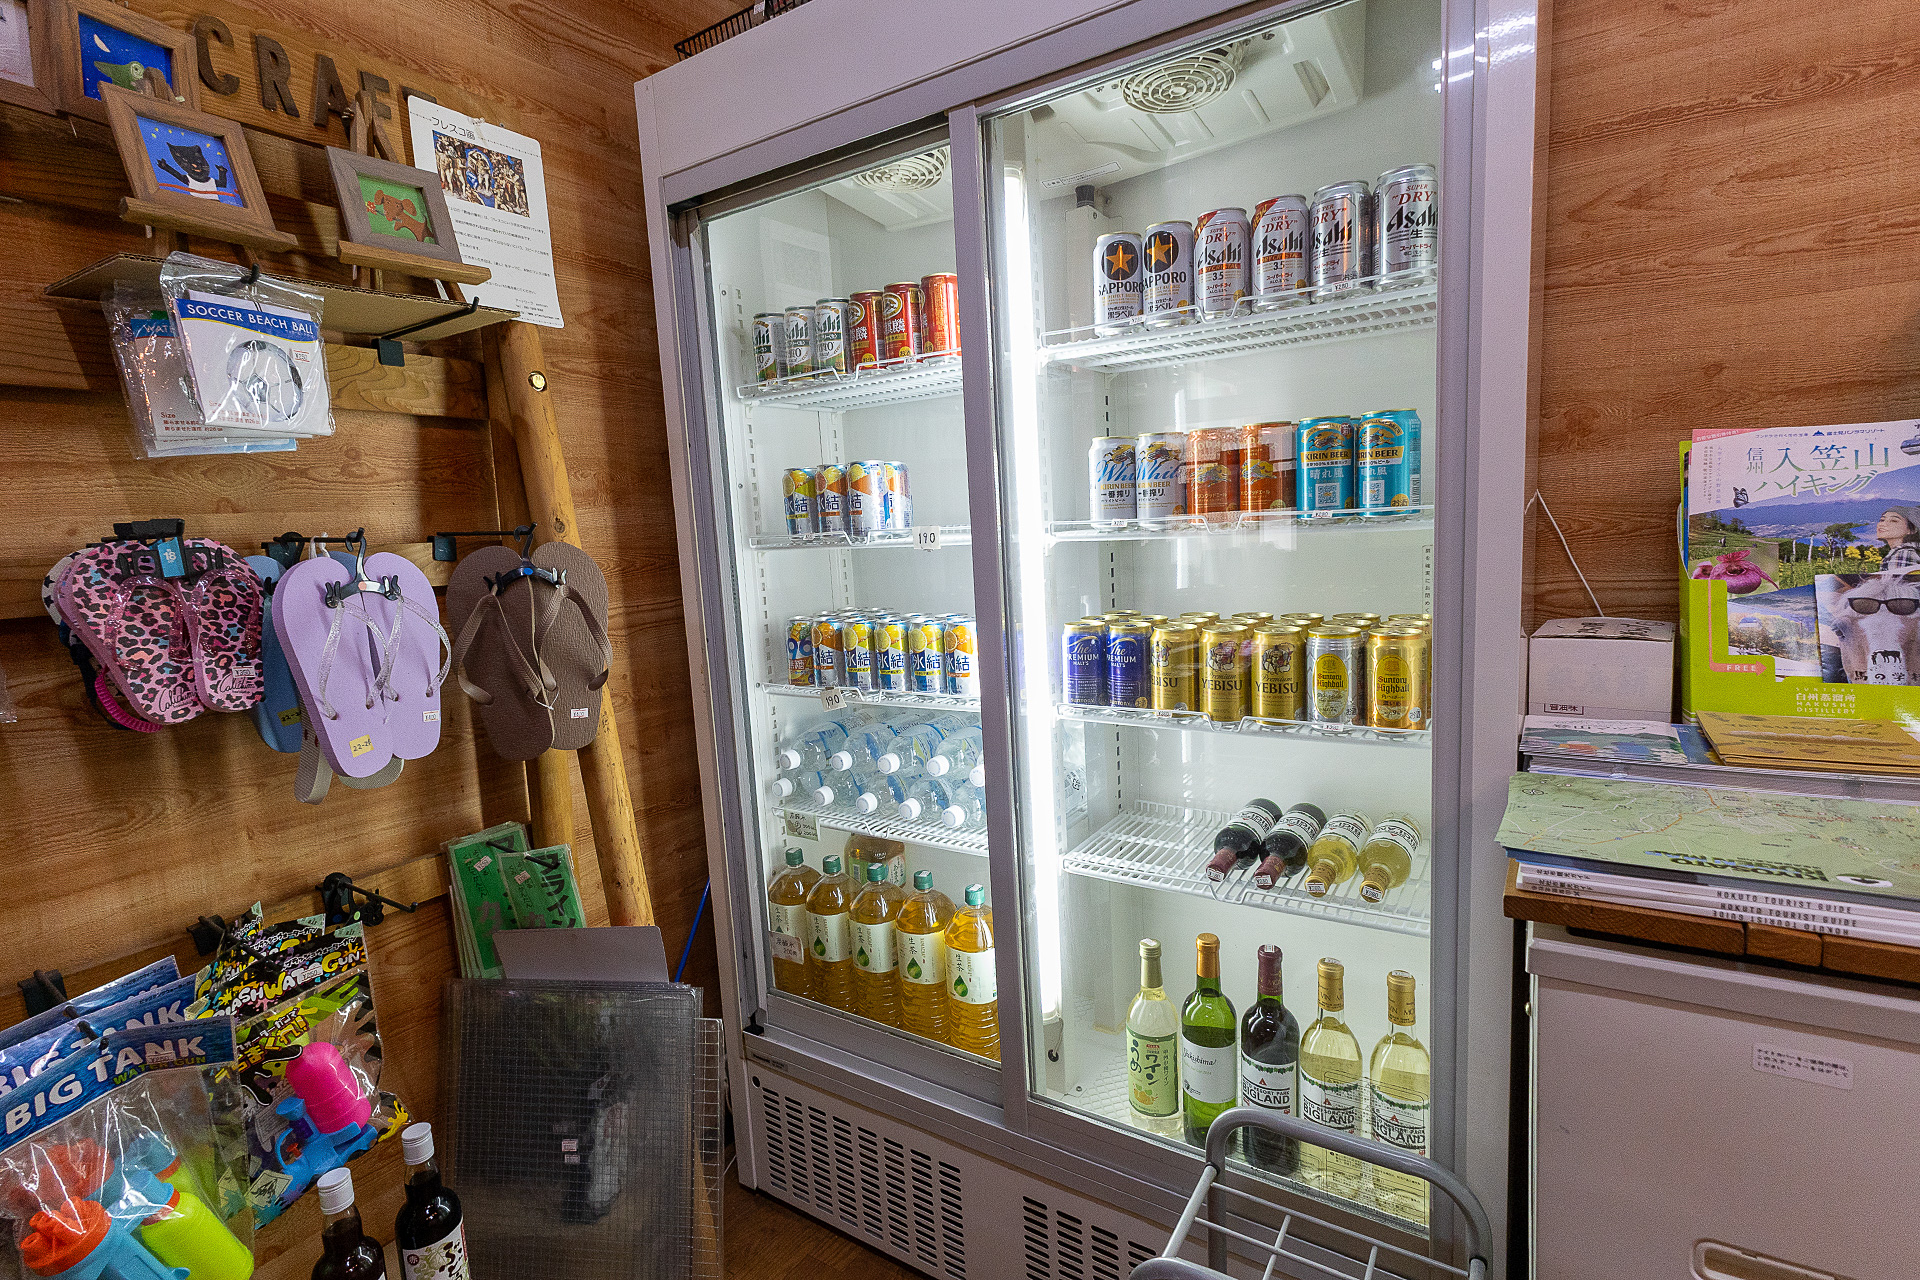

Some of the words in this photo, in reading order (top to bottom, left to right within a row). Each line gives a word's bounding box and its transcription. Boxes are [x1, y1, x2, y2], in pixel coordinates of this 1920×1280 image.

[194, 15, 437, 142] CRAF
[431, 117, 476, 141] フレスコ画
[1410, 229, 1423, 239] 生
[1256, 231, 1304, 258] Asahi
[1400, 243, 1432, 251] スーパードライ
[1198, 242, 1241, 268] Asahi
[188, 304, 244, 322] SOCCER
[248, 314, 288, 330] BEACH
[292, 321, 314, 335] BALL
[1108, 310, 1134, 320] 黒ラベル
[1305, 452, 1328, 460] KIRIN
[1330, 450, 1349, 459] BEER
[1375, 449, 1398, 457] BEER
[1769, 443, 1890, 474] 入笠山
[1747, 447, 1764, 475] 信州
[1309, 468, 1344, 479] 晴れ風
[1101, 482, 1120, 490] KIRIN
[1754, 470, 1879, 497] ハイキング
[1101, 488, 1131, 499] 一番搾り
[918, 533, 935, 544] 190
[164, 552, 176, 561] 18
[1071, 643, 1091, 653] The
[1111, 643, 1126, 655] The
[847, 651, 871, 667] 氷結
[912, 654, 941, 669] 氷結
[1202, 678, 1242, 691] YEBISU
[1262, 674, 1292, 682] Premium
[1316, 680, 1343, 689] Highball
[1377, 675, 1407, 684] Suntory
[1255, 681, 1299, 695] YEBISU
[1377, 683, 1410, 694] Highball
[825, 694, 840, 708] 190
[1796, 693, 1856, 702] 白州蒸溜所
[1717, 890, 1757, 902] HOKUTO
[1765, 897, 1811, 909] TOURIST
[1818, 904, 1852, 914] GUIDE
[1712, 910, 1744, 921] GUIDE
[1720, 902, 1761, 914] HOKUTO
[1769, 909, 1816, 922] TOURIST
[1823, 916, 1857, 927] GUIDE
[1751, 915, 1797, 929] TOURIST
[1804, 923, 1849, 935] HOKUTO
[908, 937, 918, 955] 生茶
[322, 951, 362, 974] GUN
[174, 1055, 207, 1067] GUN
[1144, 1054, 1162, 1086] ワイン
[1242, 1083, 1290, 1105] BIGLAND
[5, 1073, 83, 1135] BIG
[1303, 1101, 1355, 1125] BIGLAND
